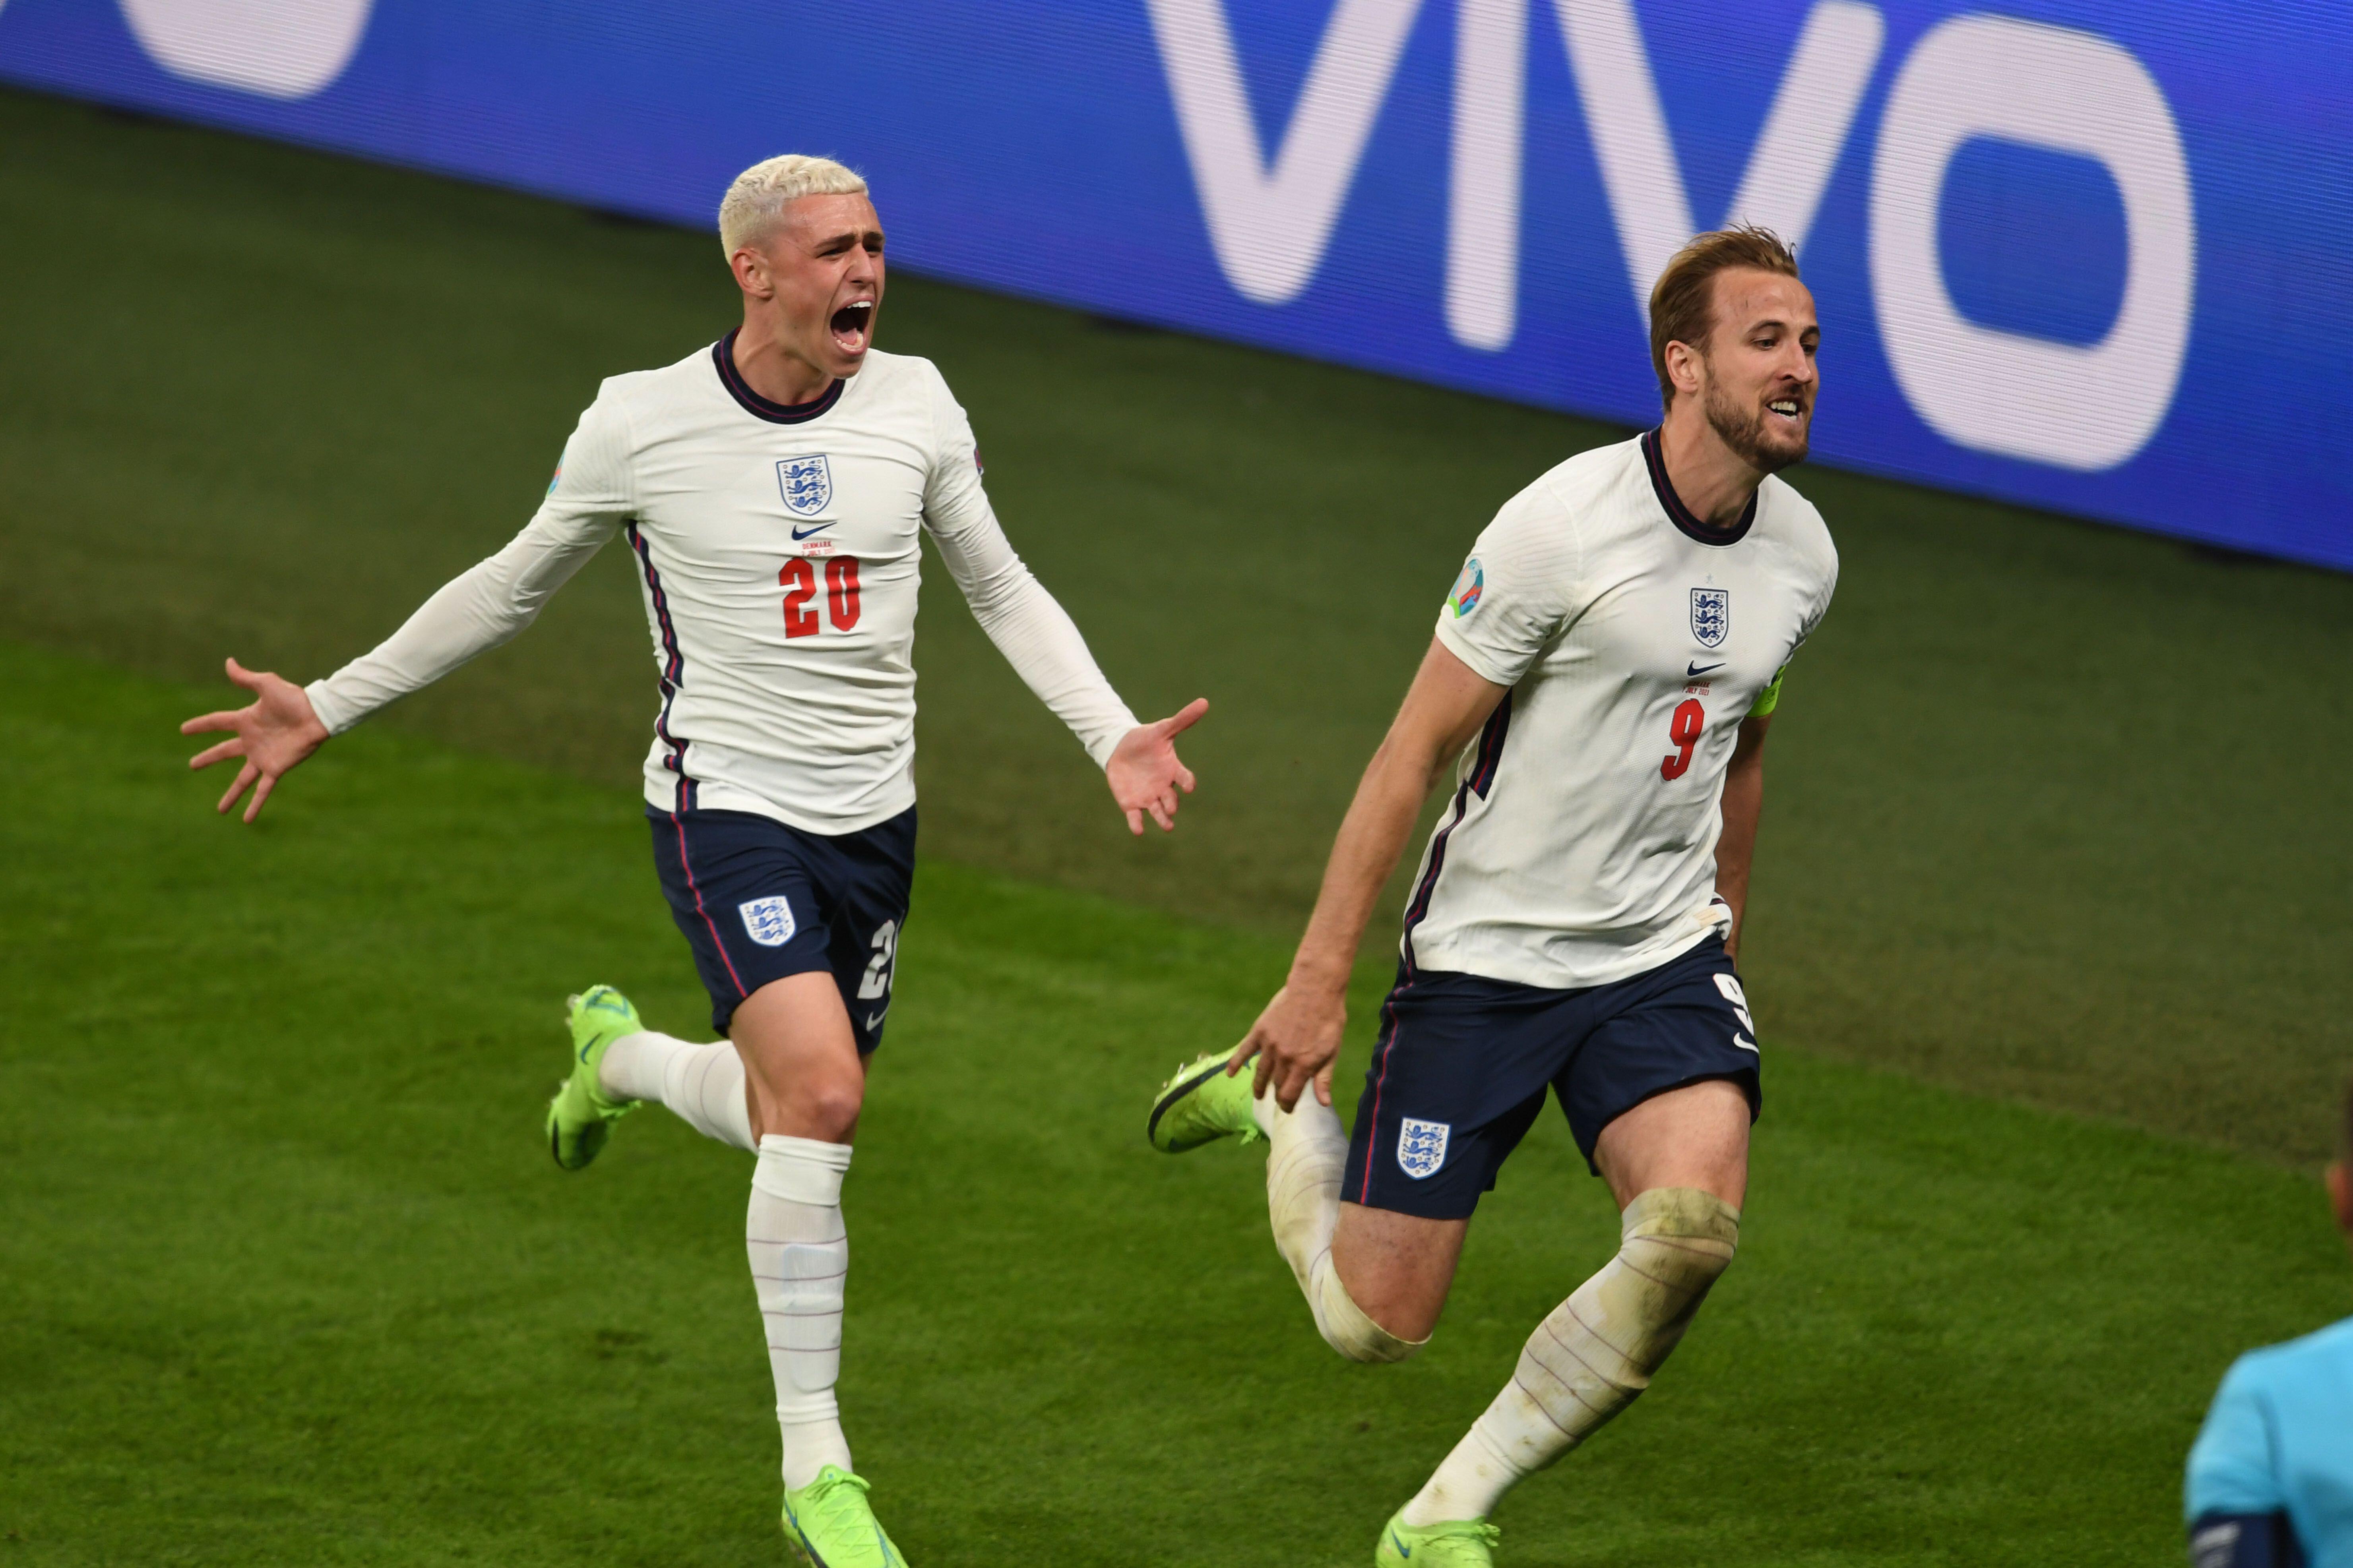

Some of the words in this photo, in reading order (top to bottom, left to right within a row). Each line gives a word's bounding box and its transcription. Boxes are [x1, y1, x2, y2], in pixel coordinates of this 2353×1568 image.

[778, 555, 861, 639] 20
[1660, 698, 1704, 781] 9
[857, 919, 899, 999] 2
[1713, 973, 1754, 1036] 9
